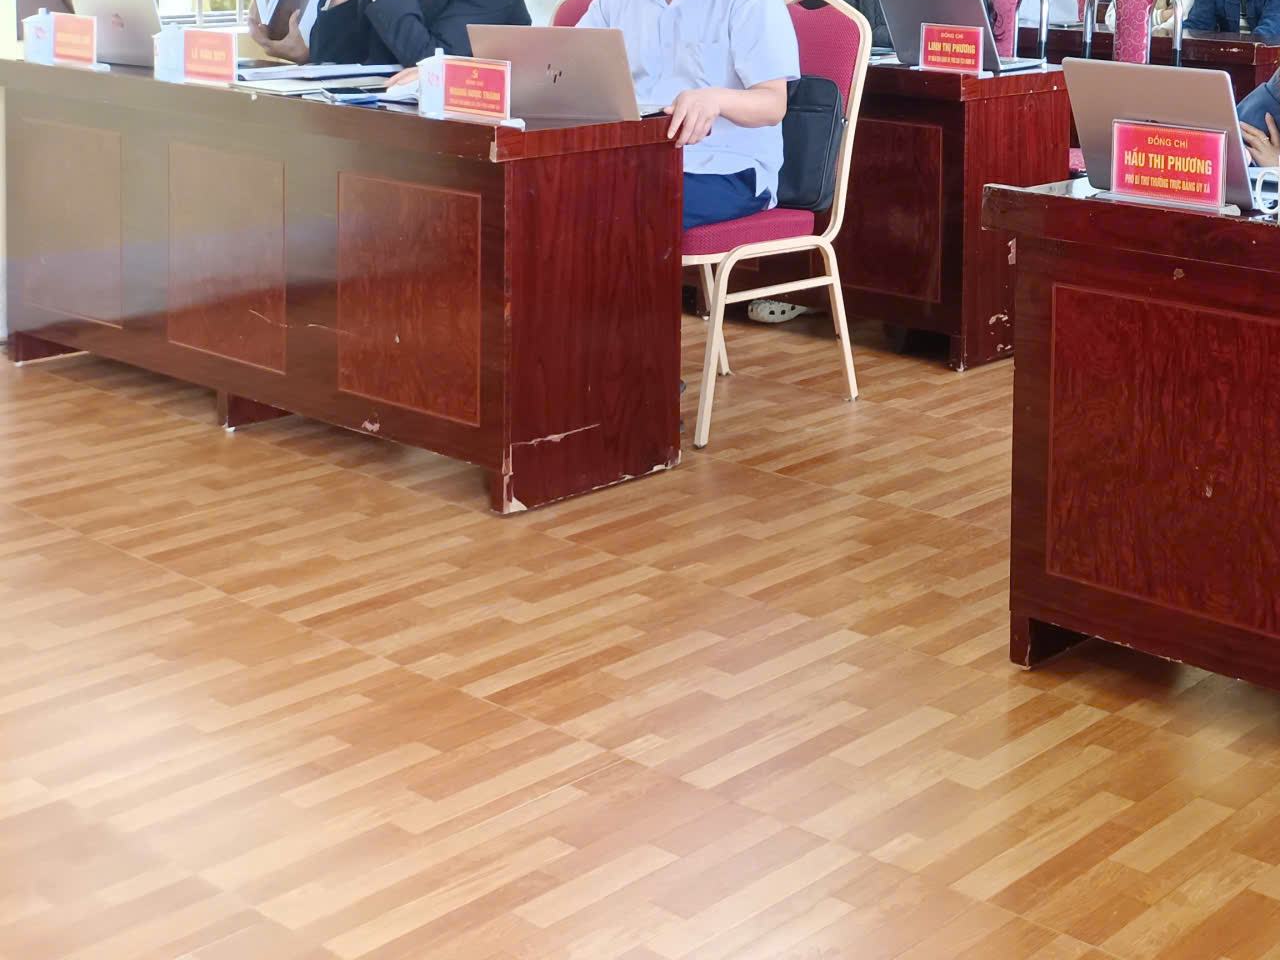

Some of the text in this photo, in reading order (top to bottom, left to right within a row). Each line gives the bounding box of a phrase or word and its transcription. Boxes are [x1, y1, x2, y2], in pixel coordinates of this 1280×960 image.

[1148, 134, 1188, 149] ĐỒNG CHÍ
[1148, 153, 1165, 172] THỊ
[1168, 155, 1213, 175] PHƯƠNG
